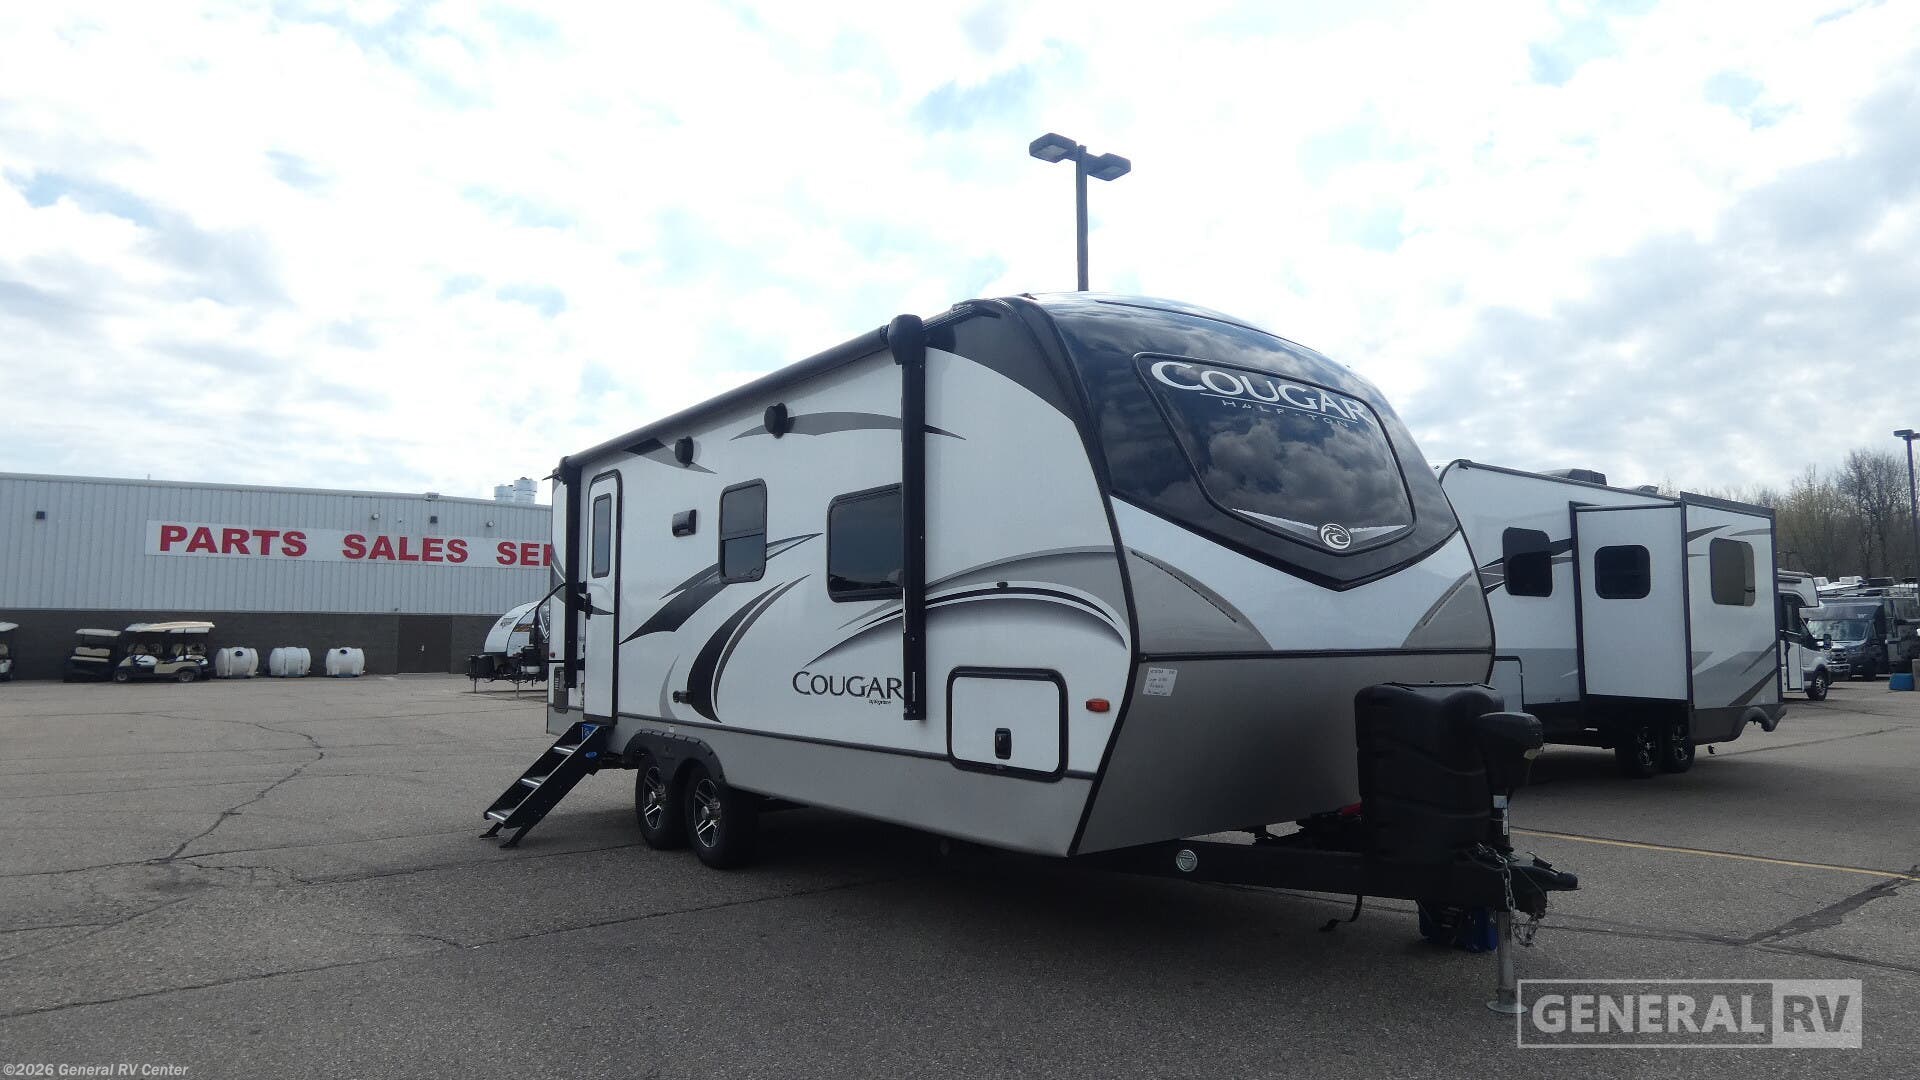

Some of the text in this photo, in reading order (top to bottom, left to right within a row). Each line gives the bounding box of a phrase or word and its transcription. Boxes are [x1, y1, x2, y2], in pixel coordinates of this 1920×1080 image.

[1151, 361, 1375, 426] COUGAR
[160, 525, 308, 557] PARTS
[342, 534, 469, 563] SALES
[792, 671, 904, 700] COUGAR
